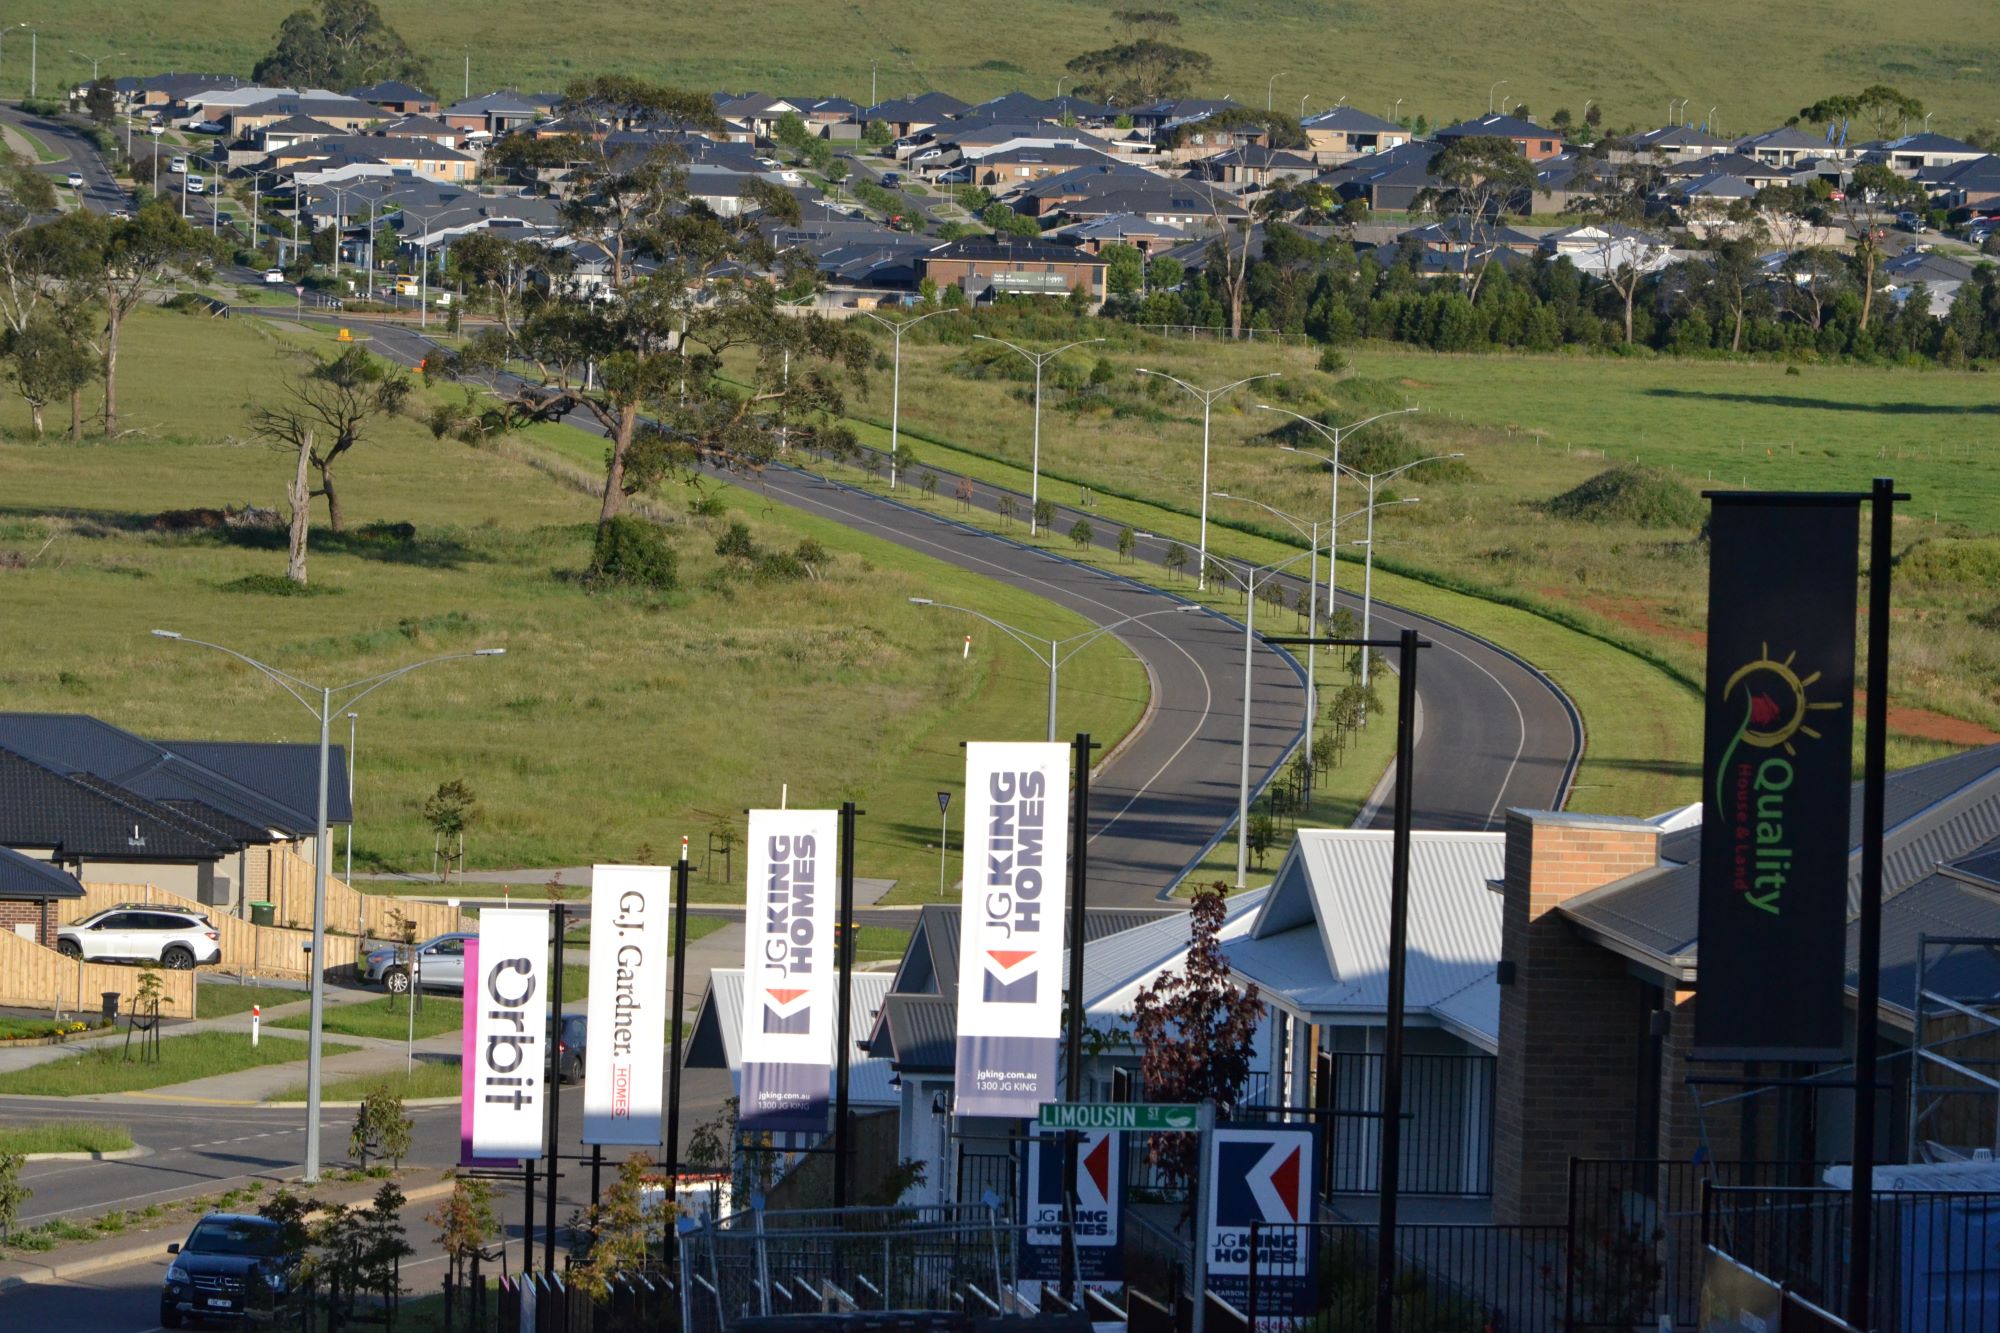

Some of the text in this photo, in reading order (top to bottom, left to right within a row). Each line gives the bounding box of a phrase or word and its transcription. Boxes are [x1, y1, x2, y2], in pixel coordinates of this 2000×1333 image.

[1736, 764, 1752, 822] House
[1015, 771, 1045, 932] HOMES
[1744, 758, 1794, 915] Quality
[1734, 844, 1748, 890] Land
[790, 834, 816, 973] HOMES
[613, 890, 645, 1057] G.J. Gardner.
[485, 957, 536, 1111] Orbit
[615, 1067, 627, 1117] HOMES
[759, 1091, 810, 1101] jgking.com.au
[977, 1070, 1037, 1080] jgking.com.au
[977, 1082, 1037, 1091] 1300 JG KING
[758, 1101, 776, 1110] 1300
[790, 1103, 810, 1111] KING
[1042, 1106, 1160, 1126] LIMOUSIN ST
